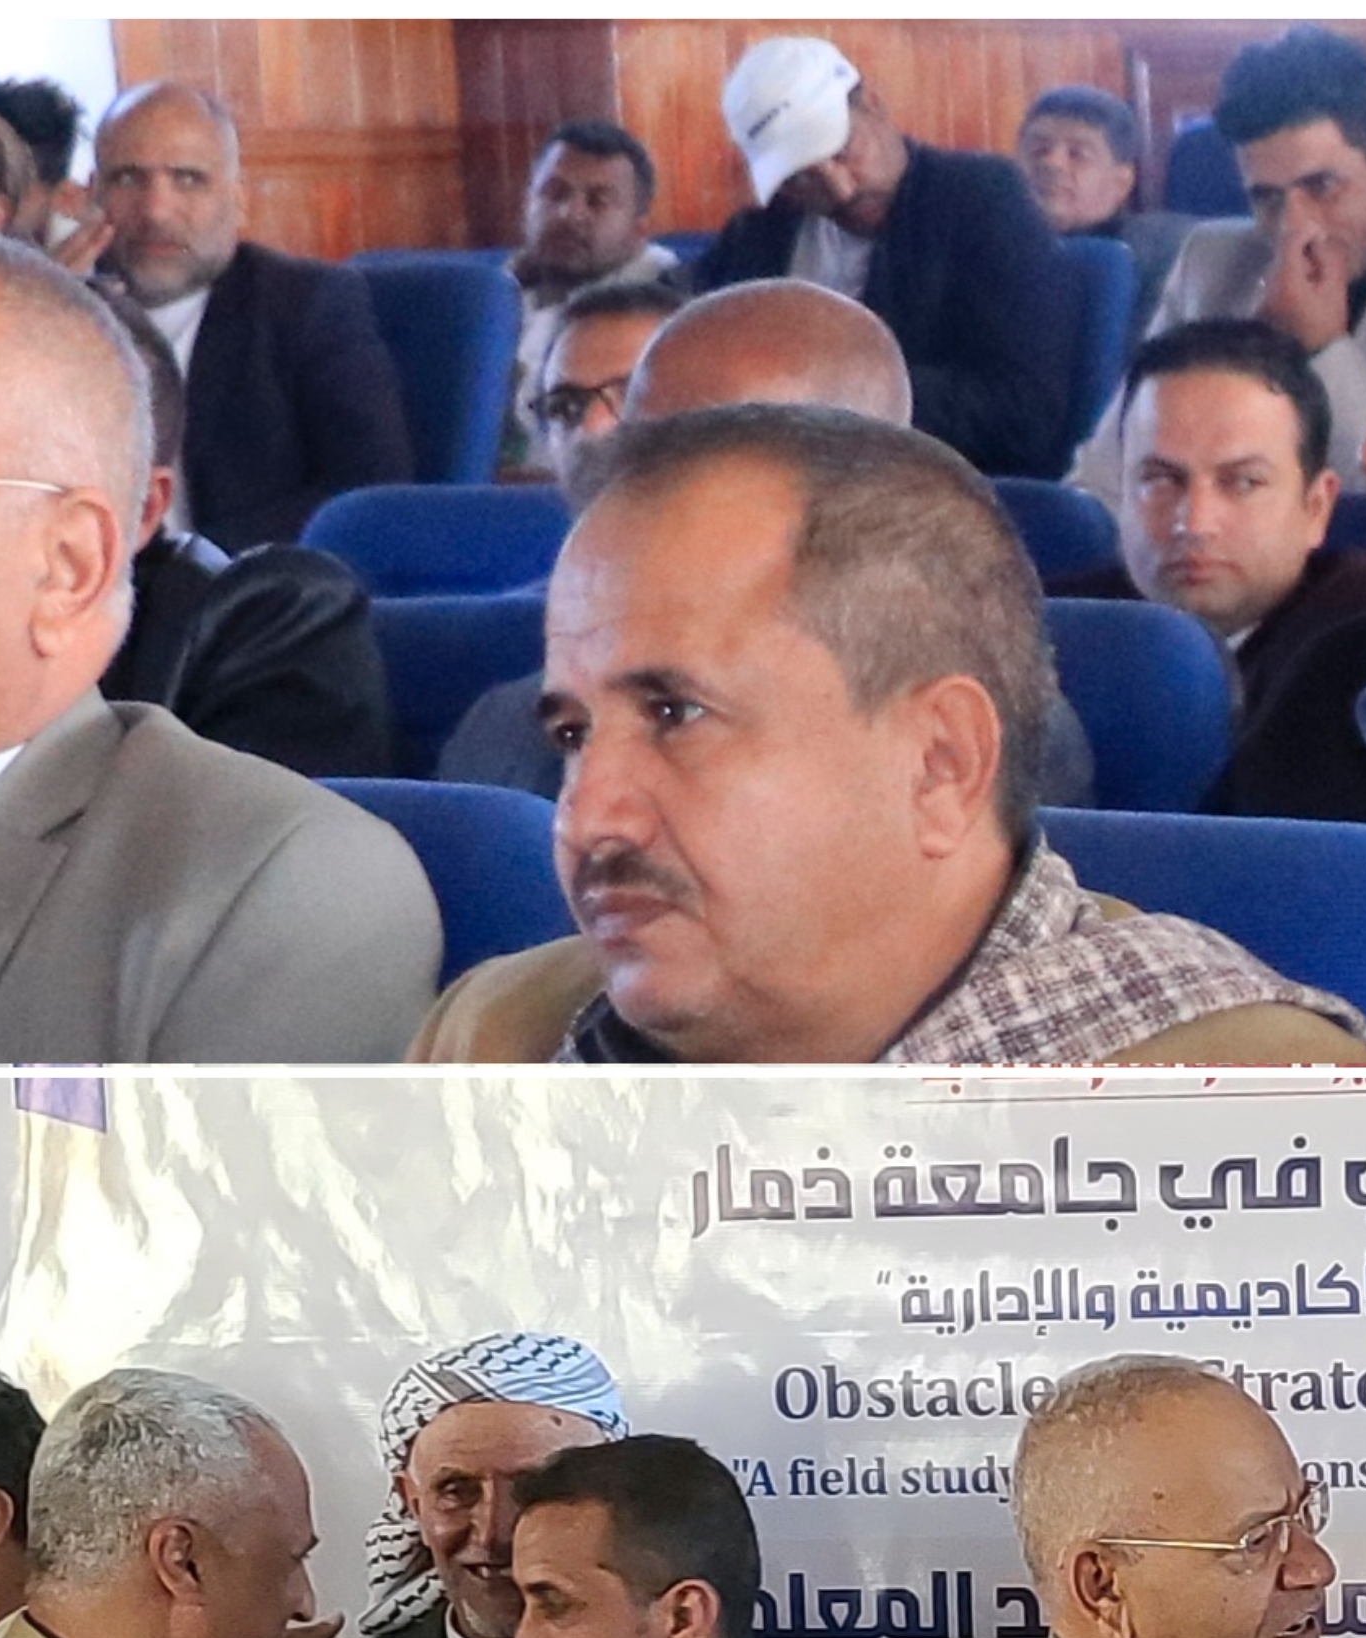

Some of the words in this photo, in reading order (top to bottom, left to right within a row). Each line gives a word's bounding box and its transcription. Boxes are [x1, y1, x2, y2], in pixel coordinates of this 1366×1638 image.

[691, 1143, 854, 1239] ذمار
[873, 1136, 1138, 1232] جامعة
[1158, 1135, 1323, 1231] في
[901, 1268, 1116, 1336] والإدارية
[775, 1361, 1055, 1420] Obstacle
[788, 1456, 888, 1497] field
